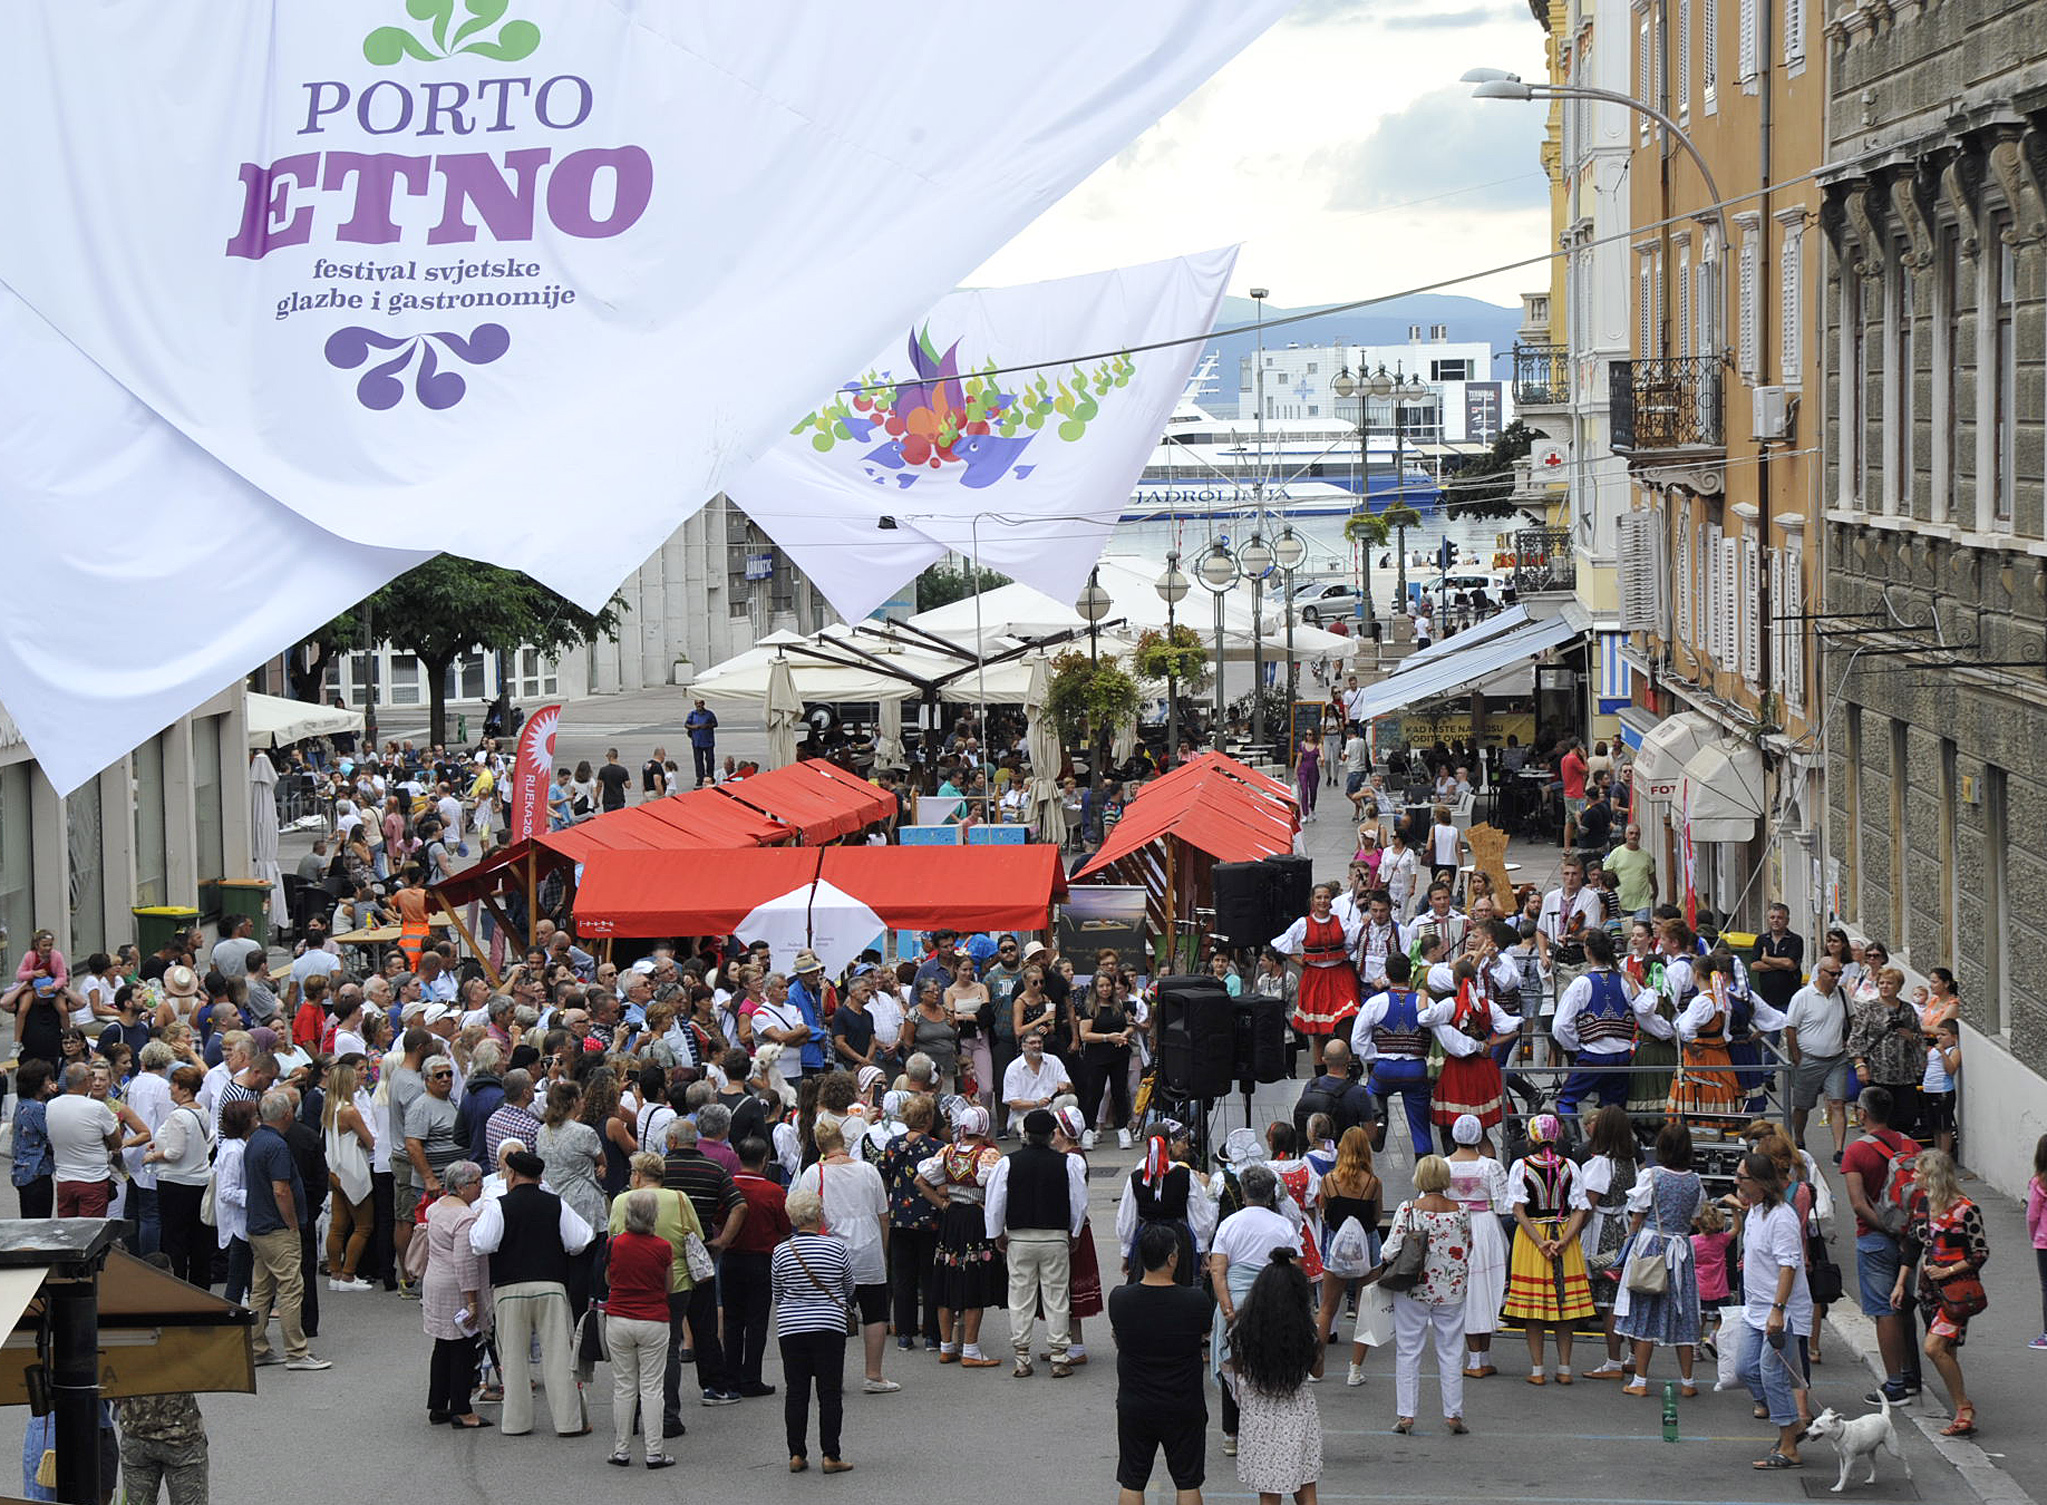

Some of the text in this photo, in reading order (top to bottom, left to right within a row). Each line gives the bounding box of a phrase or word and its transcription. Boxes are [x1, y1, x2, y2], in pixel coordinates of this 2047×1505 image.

[297, 75, 593, 135] PORTO
[226, 145, 653, 260] ETNO
[313, 258, 541, 282] festival svjetske
[275, 285, 576, 320] glazbe i gastronomije
[1136, 489, 1292, 504] JADROLINJA
